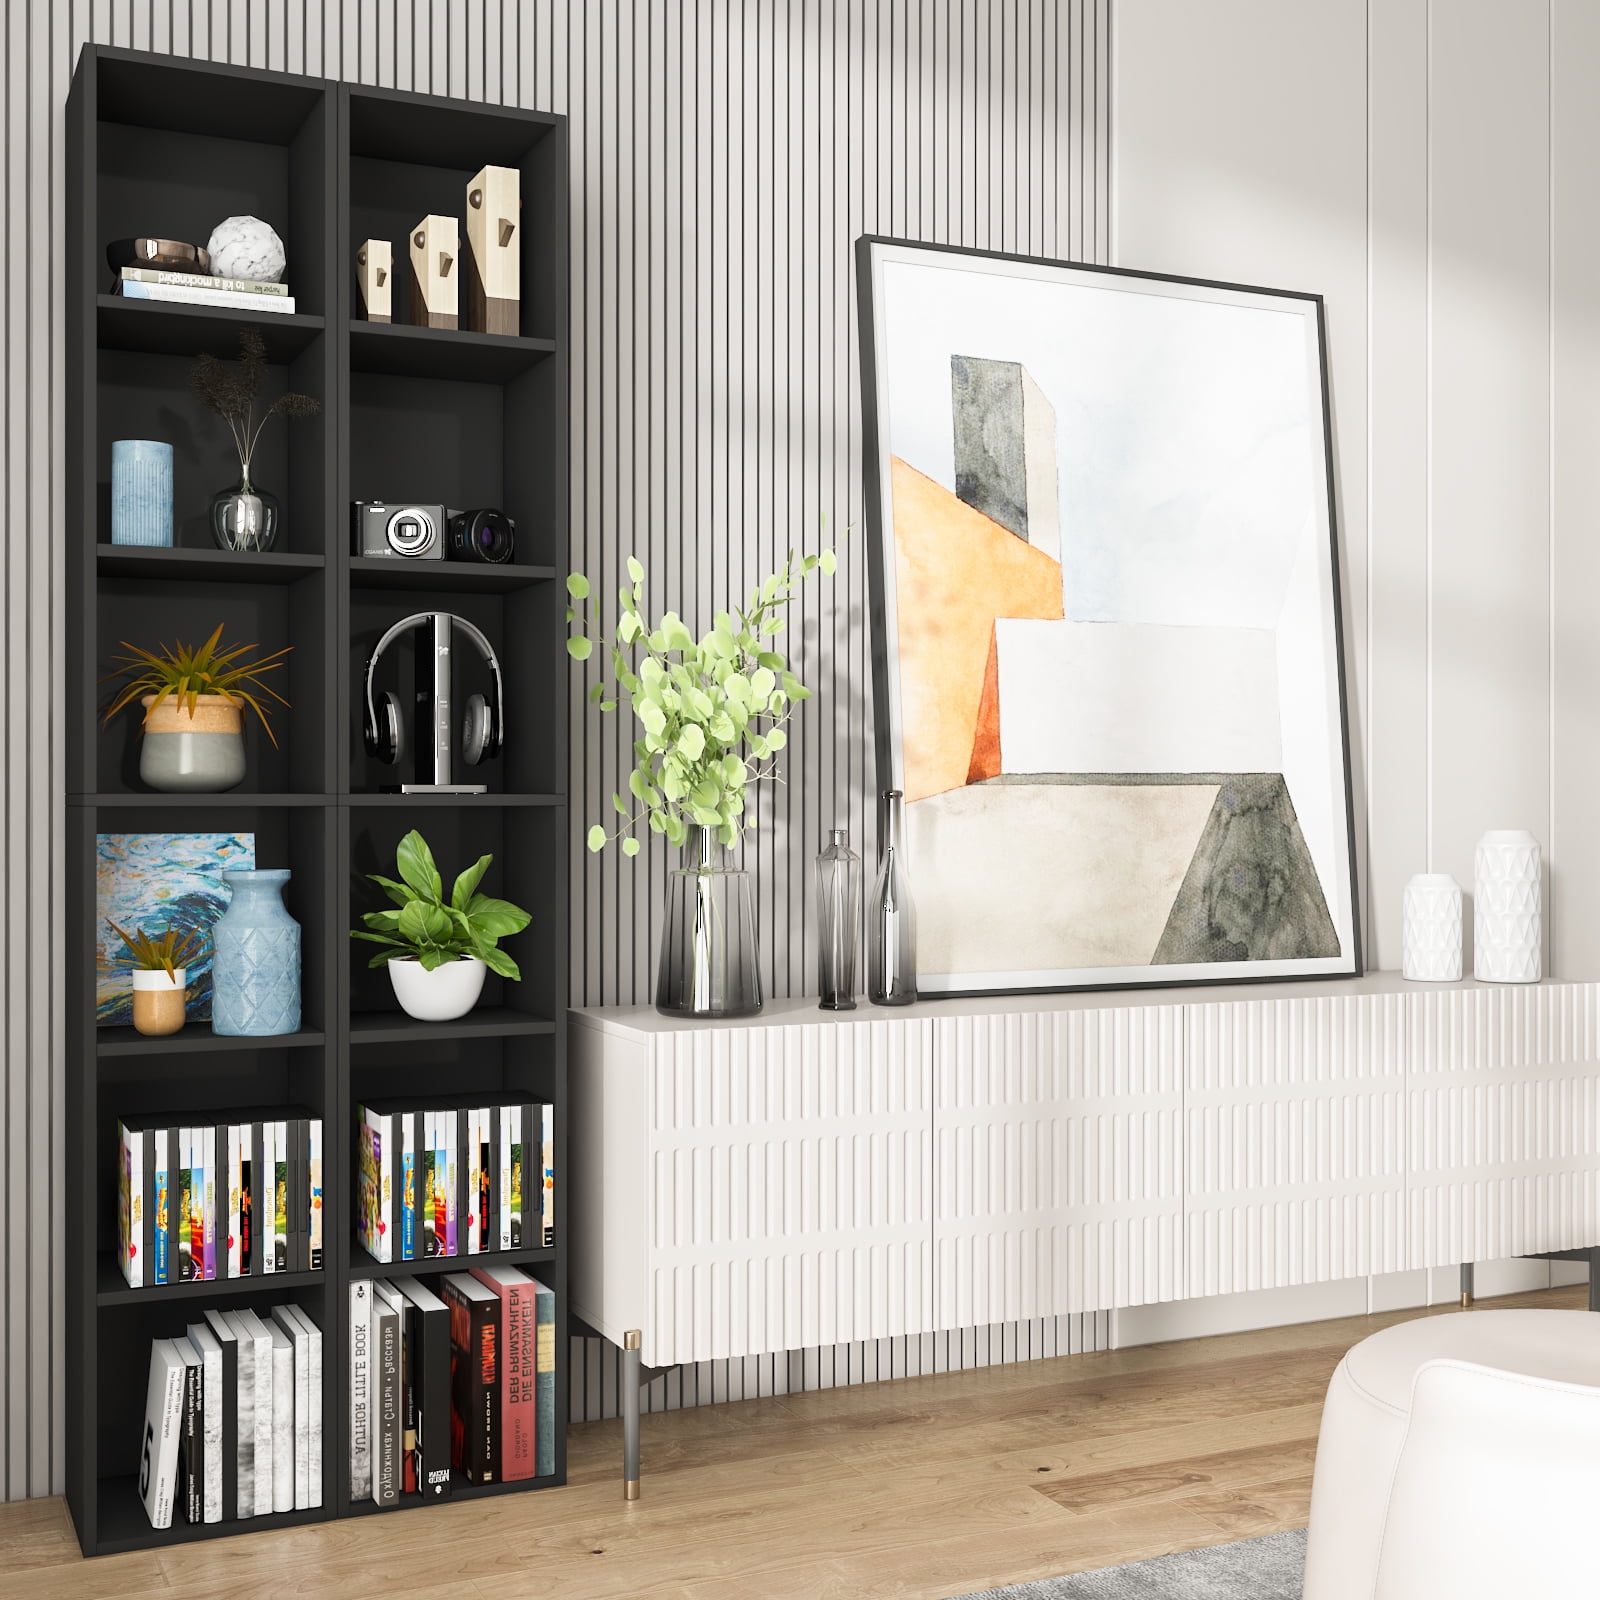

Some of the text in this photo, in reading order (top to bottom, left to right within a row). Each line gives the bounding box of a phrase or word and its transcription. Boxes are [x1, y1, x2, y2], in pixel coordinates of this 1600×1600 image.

[158, 272, 212, 287] mockingbird
[222, 280, 234, 290] kill
[236, 281, 245, 290] to
